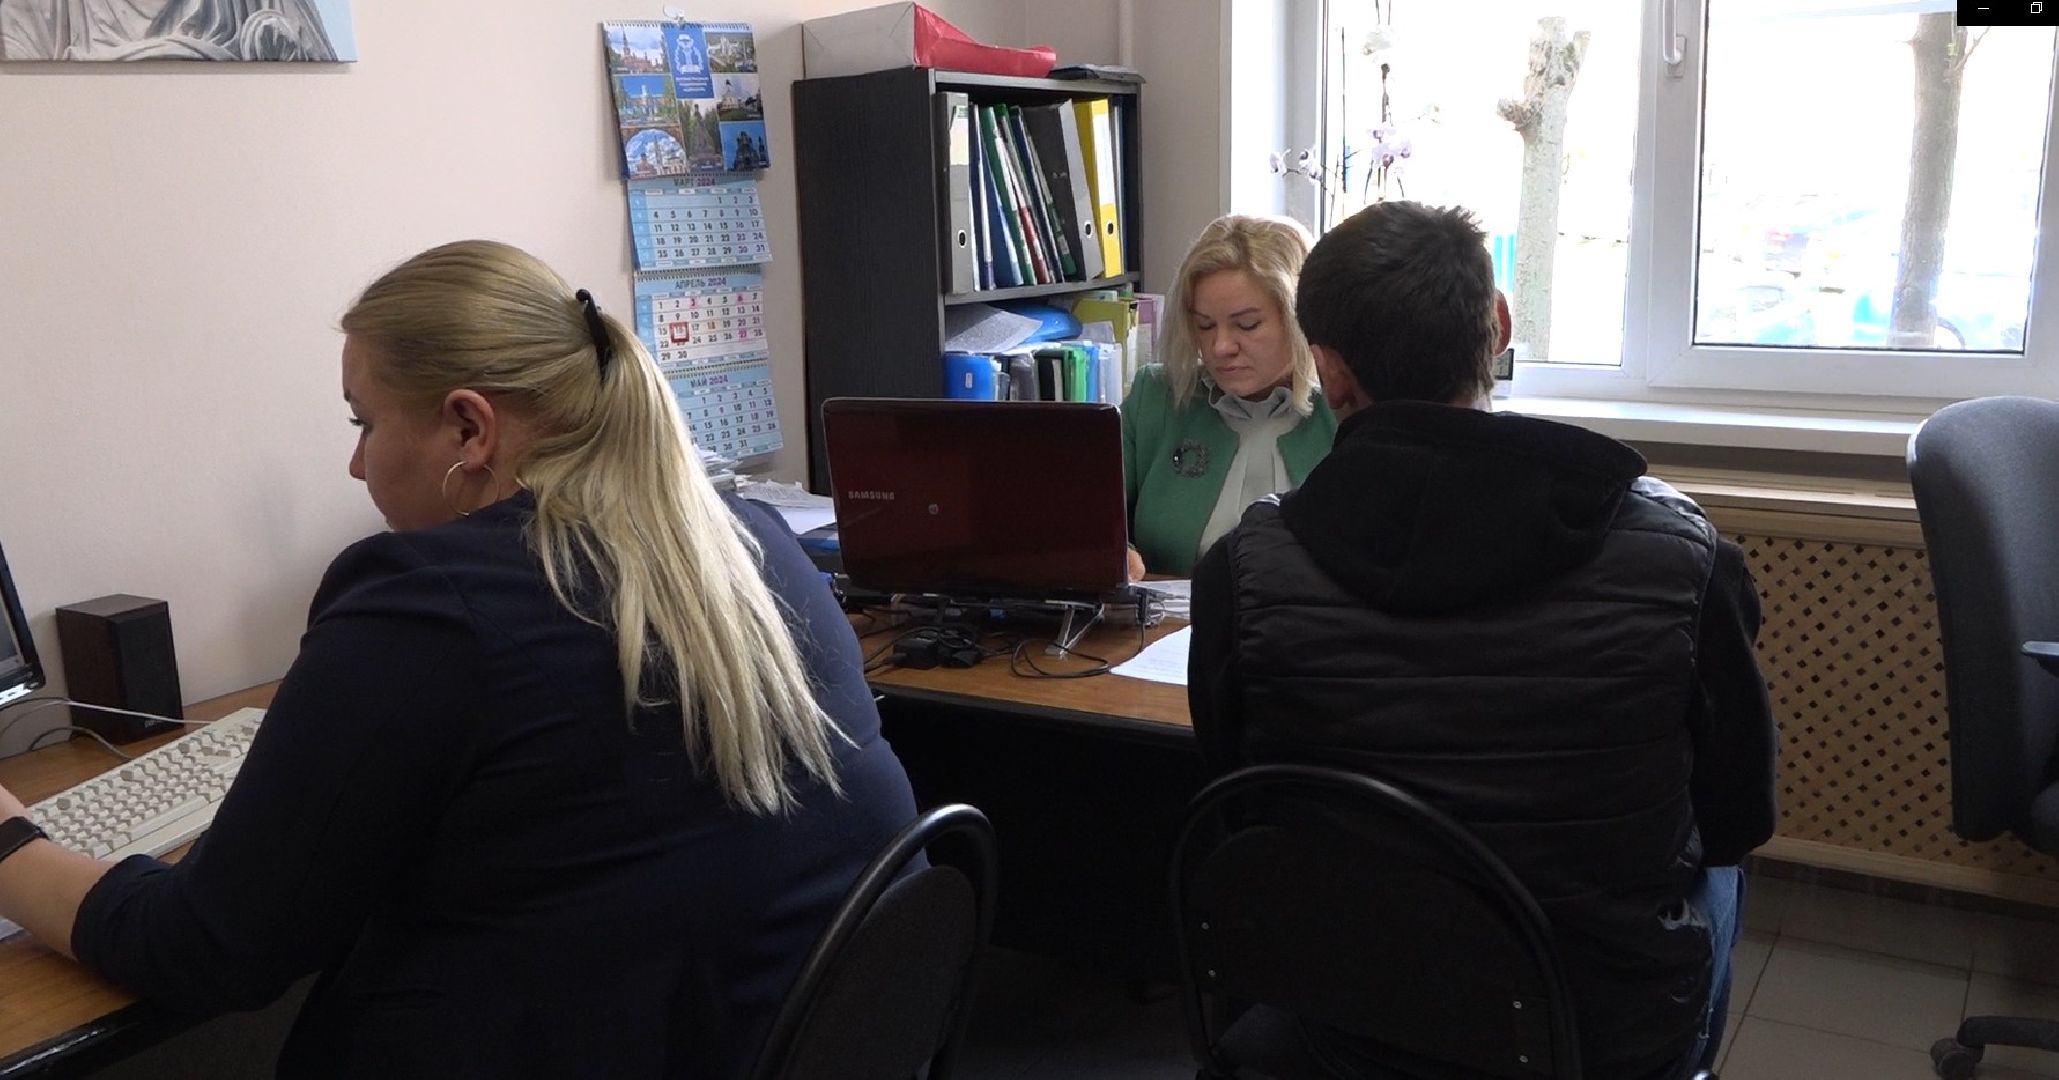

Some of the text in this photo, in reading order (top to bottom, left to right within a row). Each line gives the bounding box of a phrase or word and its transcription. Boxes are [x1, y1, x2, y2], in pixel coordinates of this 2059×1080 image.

[697, 178, 716, 187] 2024
[675, 277, 727, 289] АПРЕЛЬ 2024
[690, 374, 728, 388] МАЙ 2024
[848, 491, 895, 500] SAMSUNG
